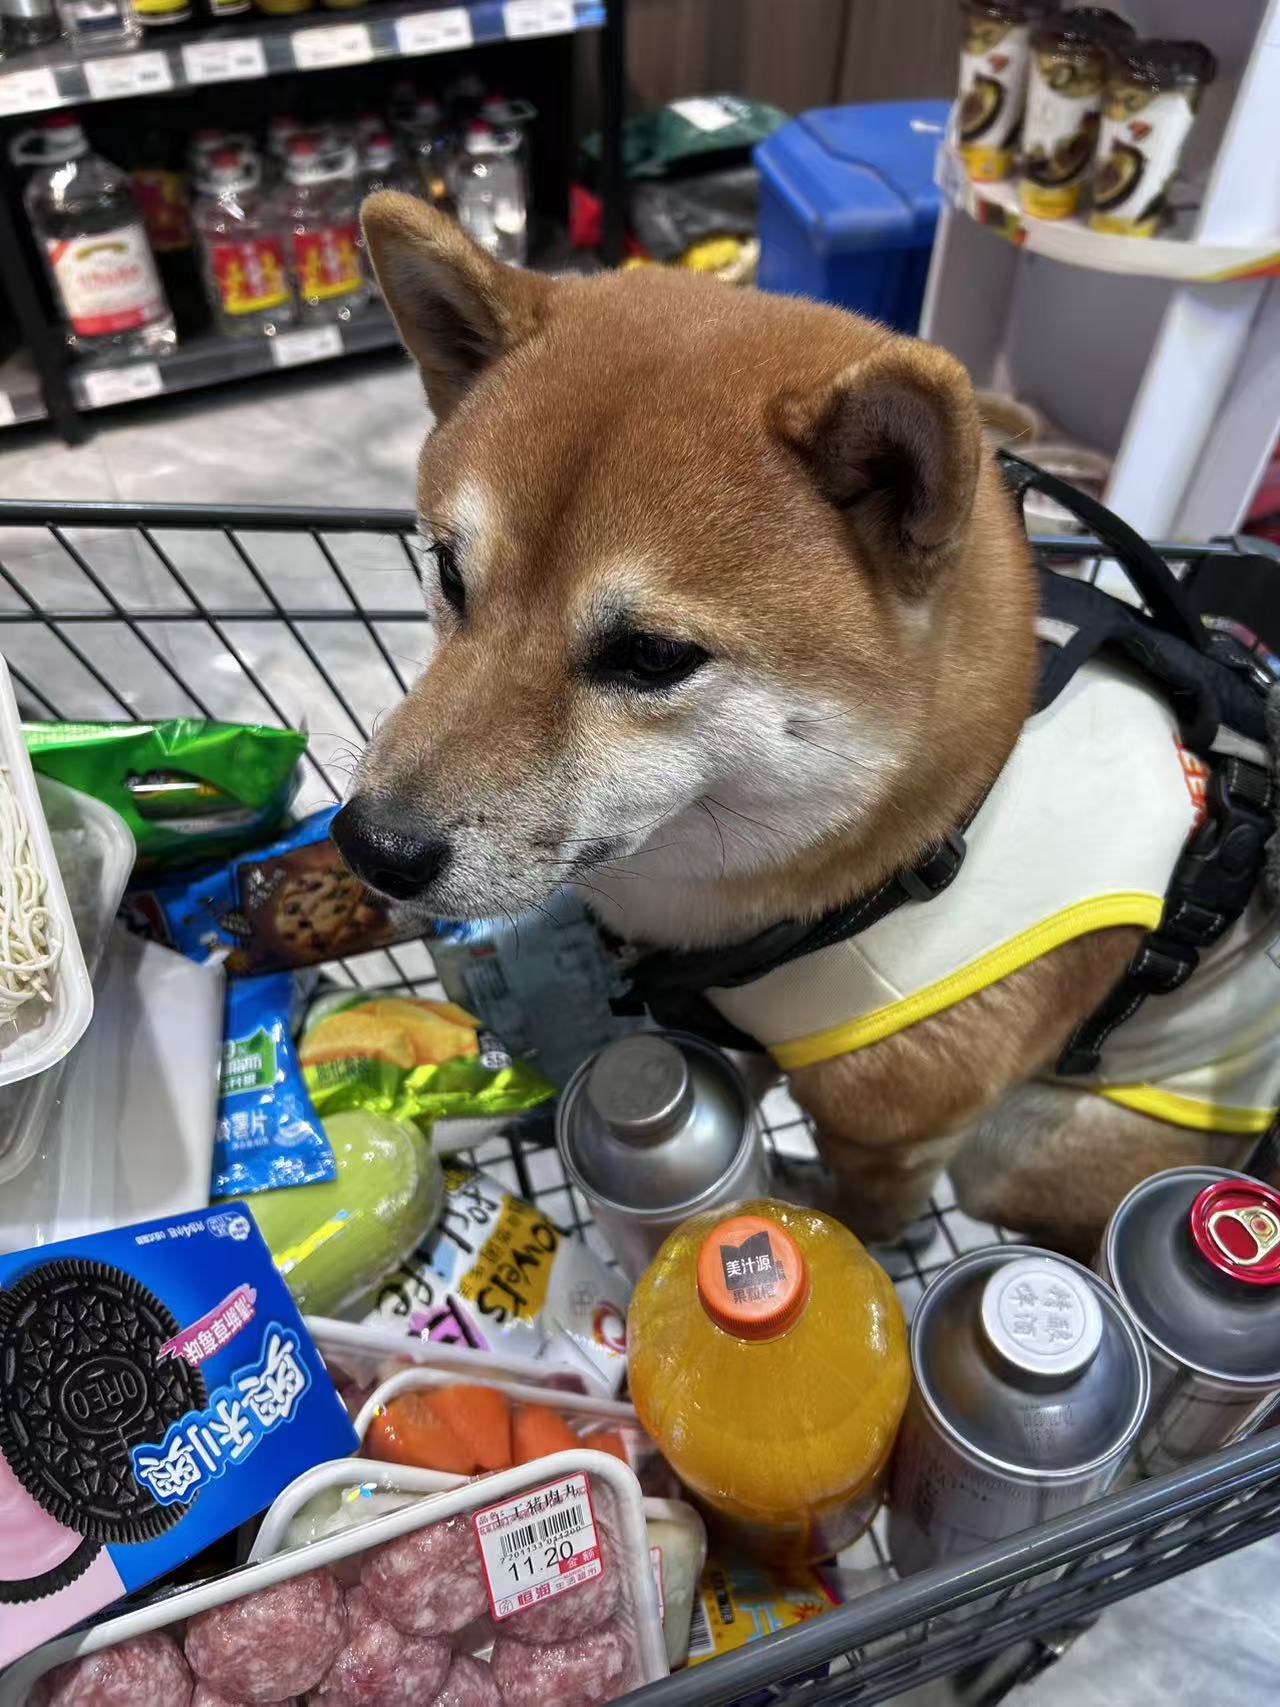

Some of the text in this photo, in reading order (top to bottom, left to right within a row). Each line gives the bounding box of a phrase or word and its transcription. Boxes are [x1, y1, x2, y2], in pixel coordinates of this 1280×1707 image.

[725, 1254, 772, 1277] 美汁源
[182, 1293, 256, 1365] 清新草莓味
[71, 1369, 138, 1419] OREO
[138, 1334, 306, 1499] 奥利奥
[507, 1540, 574, 1582] 11.20
